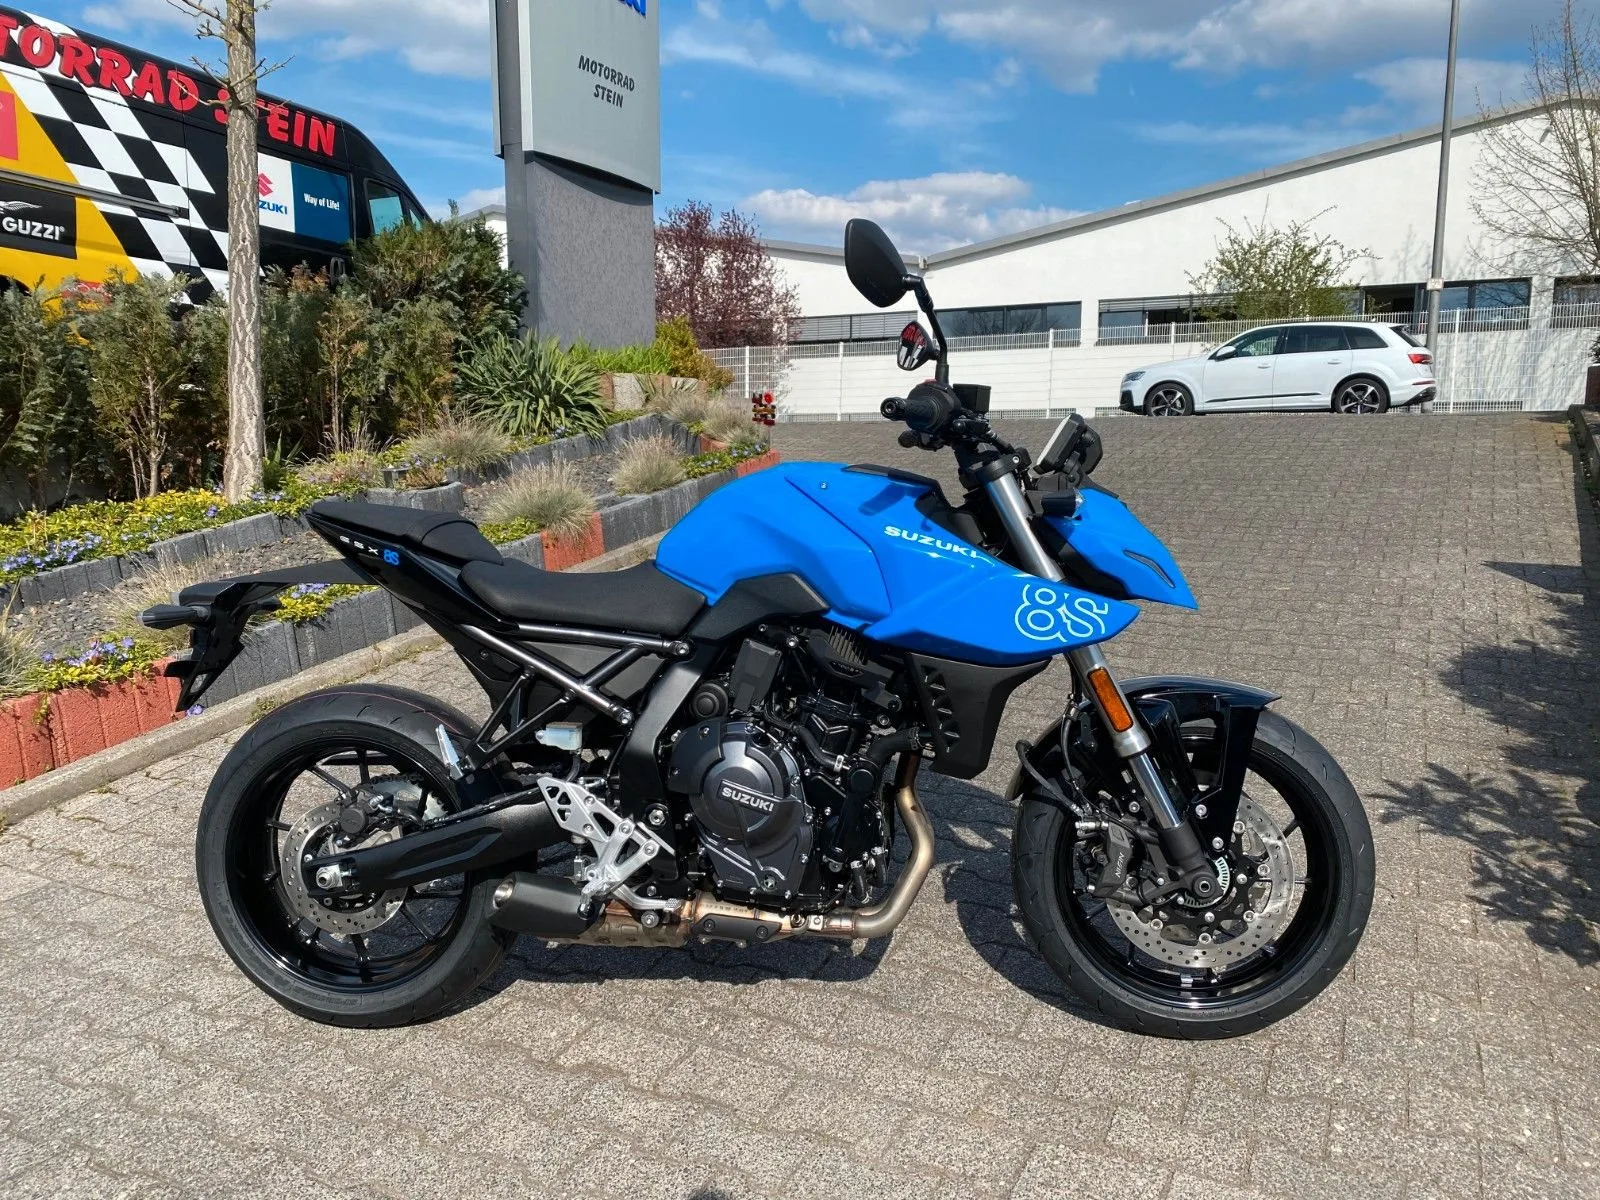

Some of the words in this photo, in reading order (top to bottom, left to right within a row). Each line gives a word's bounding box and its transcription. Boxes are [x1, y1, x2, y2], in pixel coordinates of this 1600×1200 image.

[578, 54, 636, 92] MOTORRAD
[593, 84, 624, 109] STEIN
[213, 88, 335, 157] EIN
[257, 200, 288, 215] ZUKI
[303, 192, 318, 206] Way
[318, 197, 326, 207] of
[326, 199, 340, 211] Life!
[882, 525, 978, 559] SUZUKI
[721, 786, 775, 812] SUZUKI
